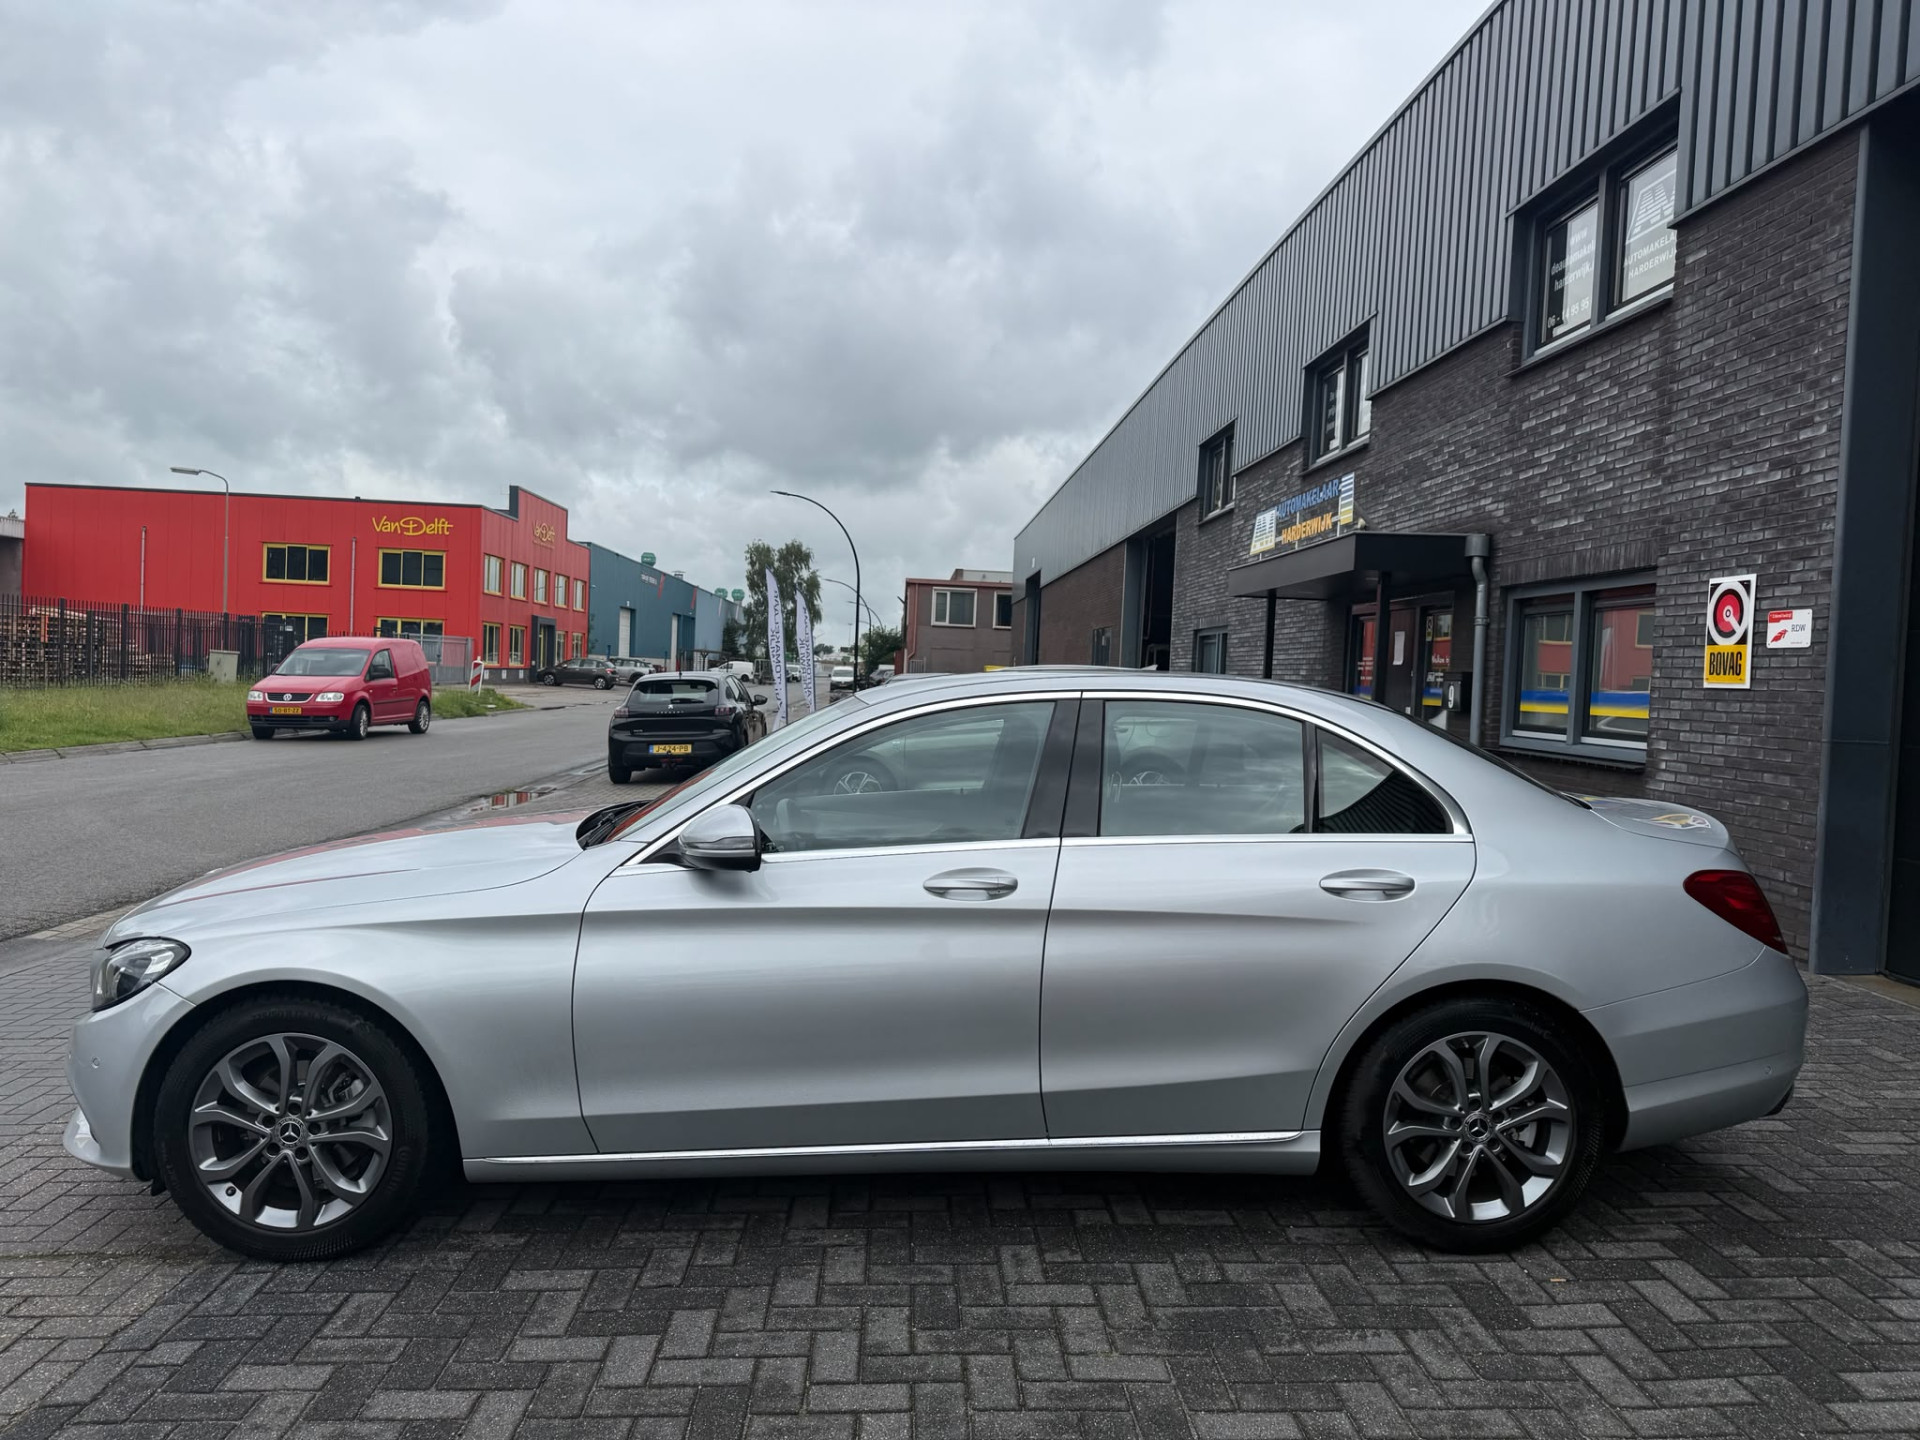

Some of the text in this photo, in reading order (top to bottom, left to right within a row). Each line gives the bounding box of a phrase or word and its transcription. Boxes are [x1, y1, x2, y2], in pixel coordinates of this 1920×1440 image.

[1624, 231, 1675, 268] AUTOMAKELA
[1628, 248, 1676, 280] HARDERWIJ
[1275, 479, 1340, 520] AUTOMAKELAAR
[1281, 512, 1333, 545] HARDERWIJK
[1709, 651, 1742, 677] BOVAG
[1448, 685, 1454, 709] 9
